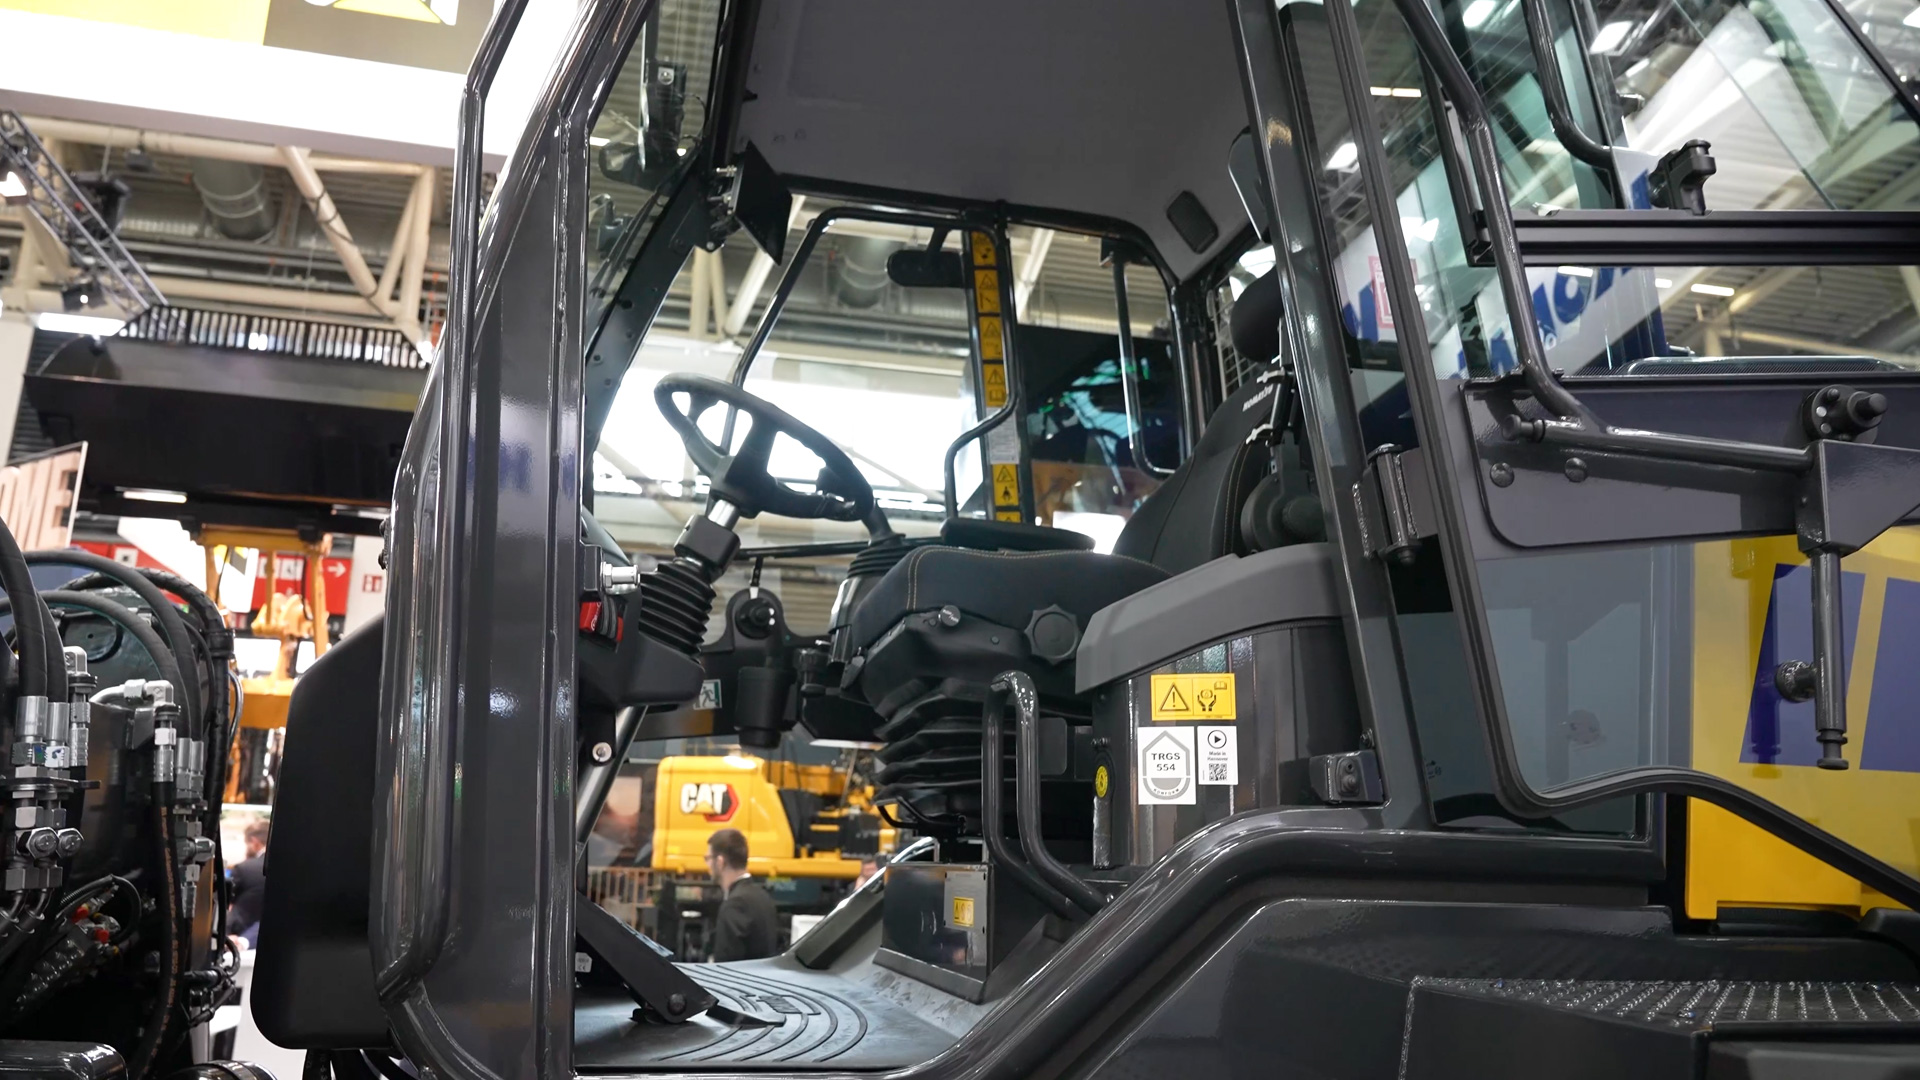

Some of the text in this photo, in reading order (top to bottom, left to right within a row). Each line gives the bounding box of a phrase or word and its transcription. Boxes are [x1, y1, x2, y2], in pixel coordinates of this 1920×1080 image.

[1151, 752, 1181, 761] TRGS
[1156, 763, 1176, 771] 554
[680, 783, 728, 814] CAT
